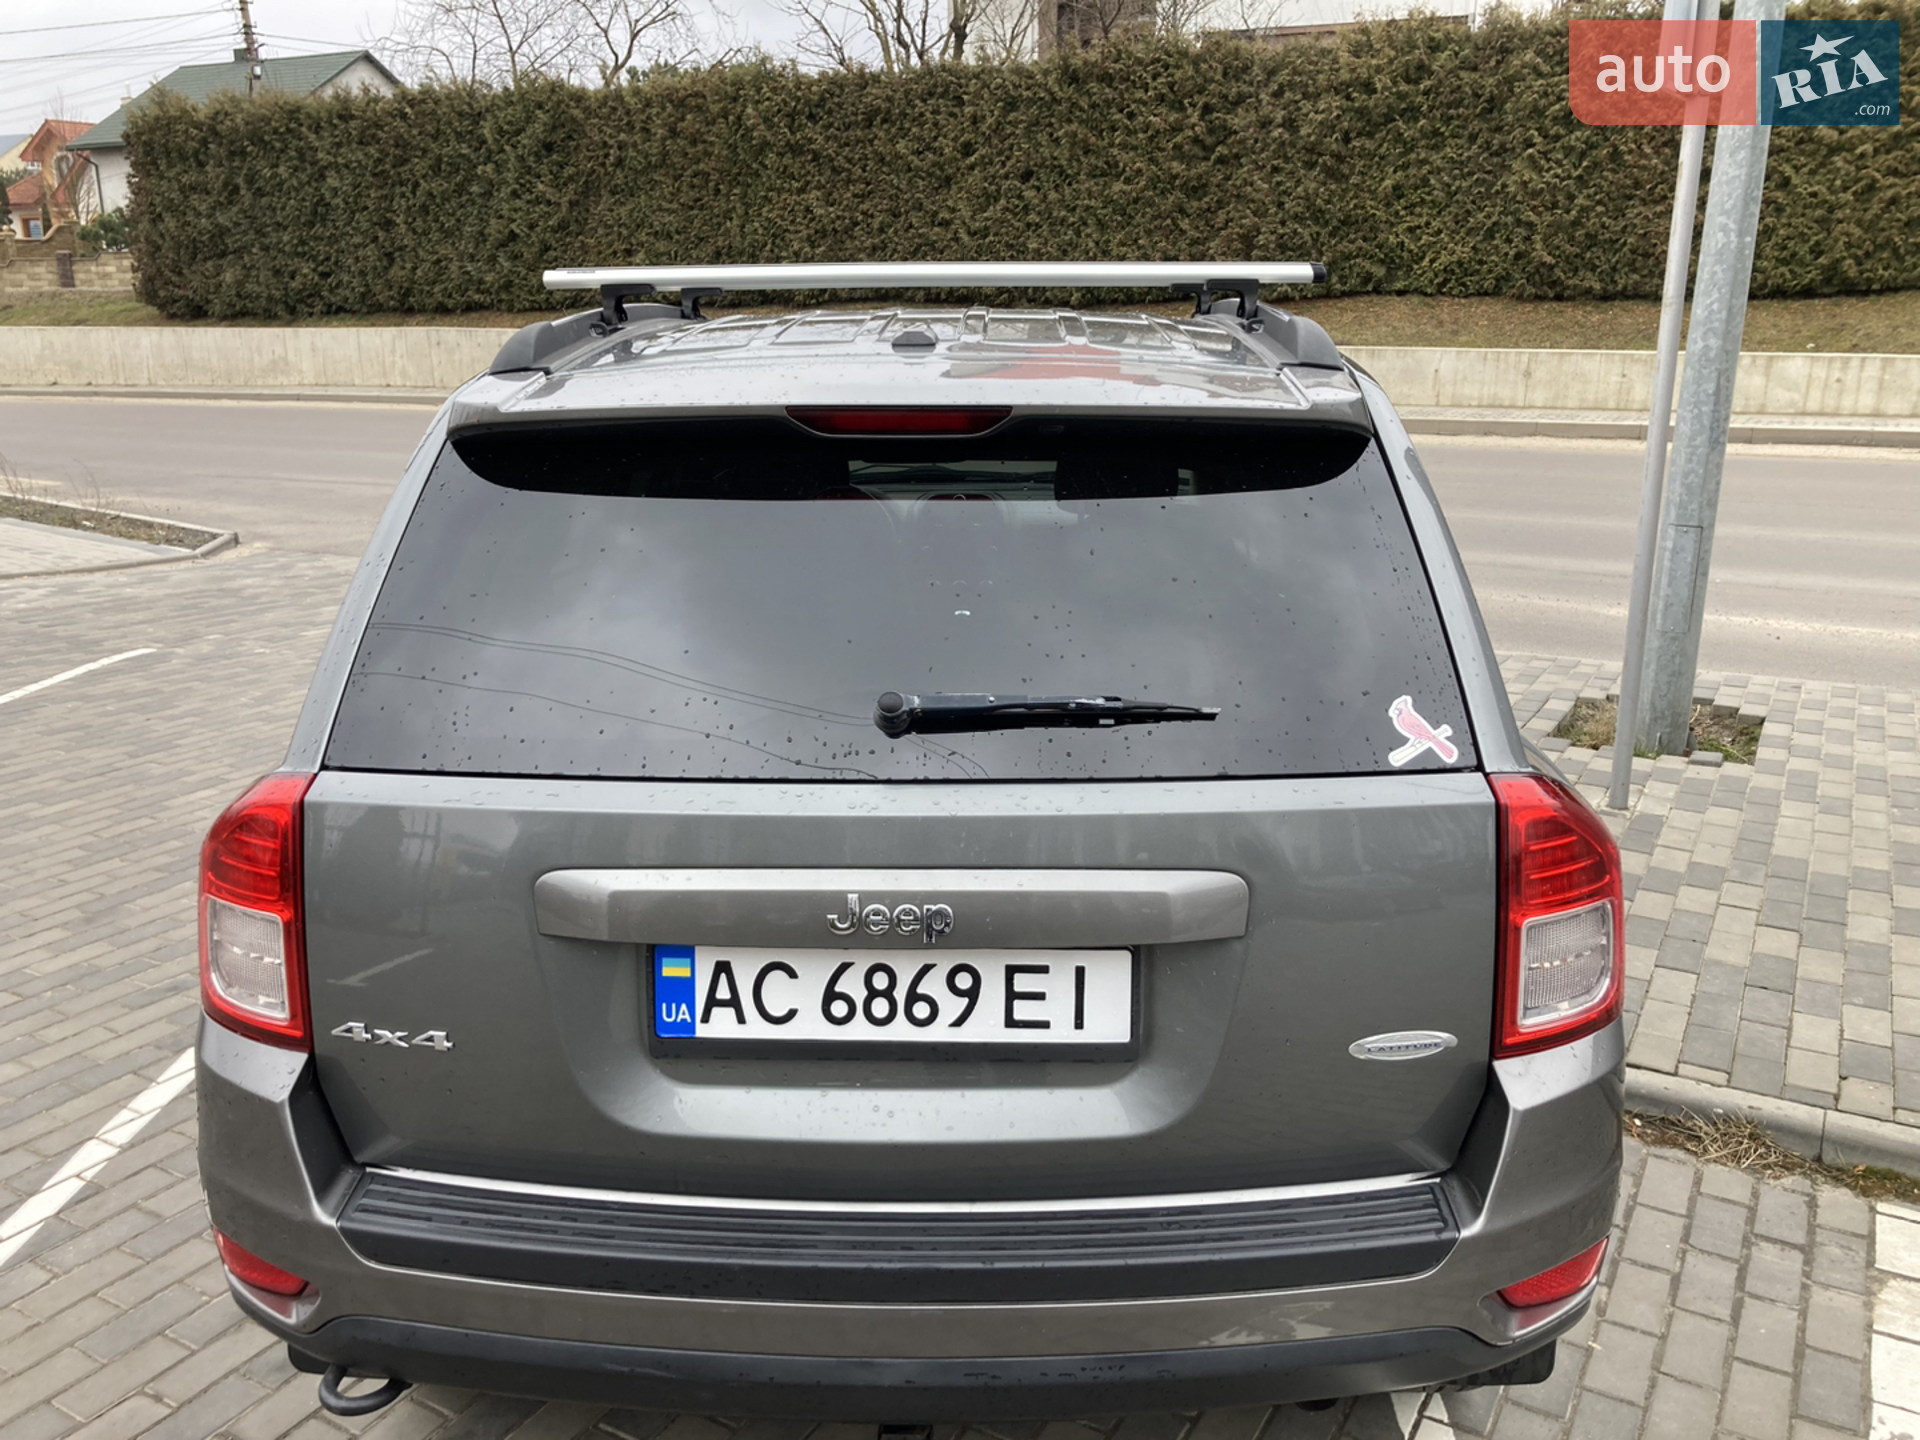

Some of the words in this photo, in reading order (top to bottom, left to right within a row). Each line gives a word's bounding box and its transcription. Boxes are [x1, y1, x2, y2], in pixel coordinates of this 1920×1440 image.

[826, 893, 954, 943] Jeep
[699, 960, 800, 1026] AC
[820, 961, 983, 1028] 6869
[1004, 963, 1086, 1030] EI
[661, 1003, 692, 1024] UA
[331, 1021, 455, 1052] 4x4
[1365, 1040, 1443, 1053] LATITUDE
